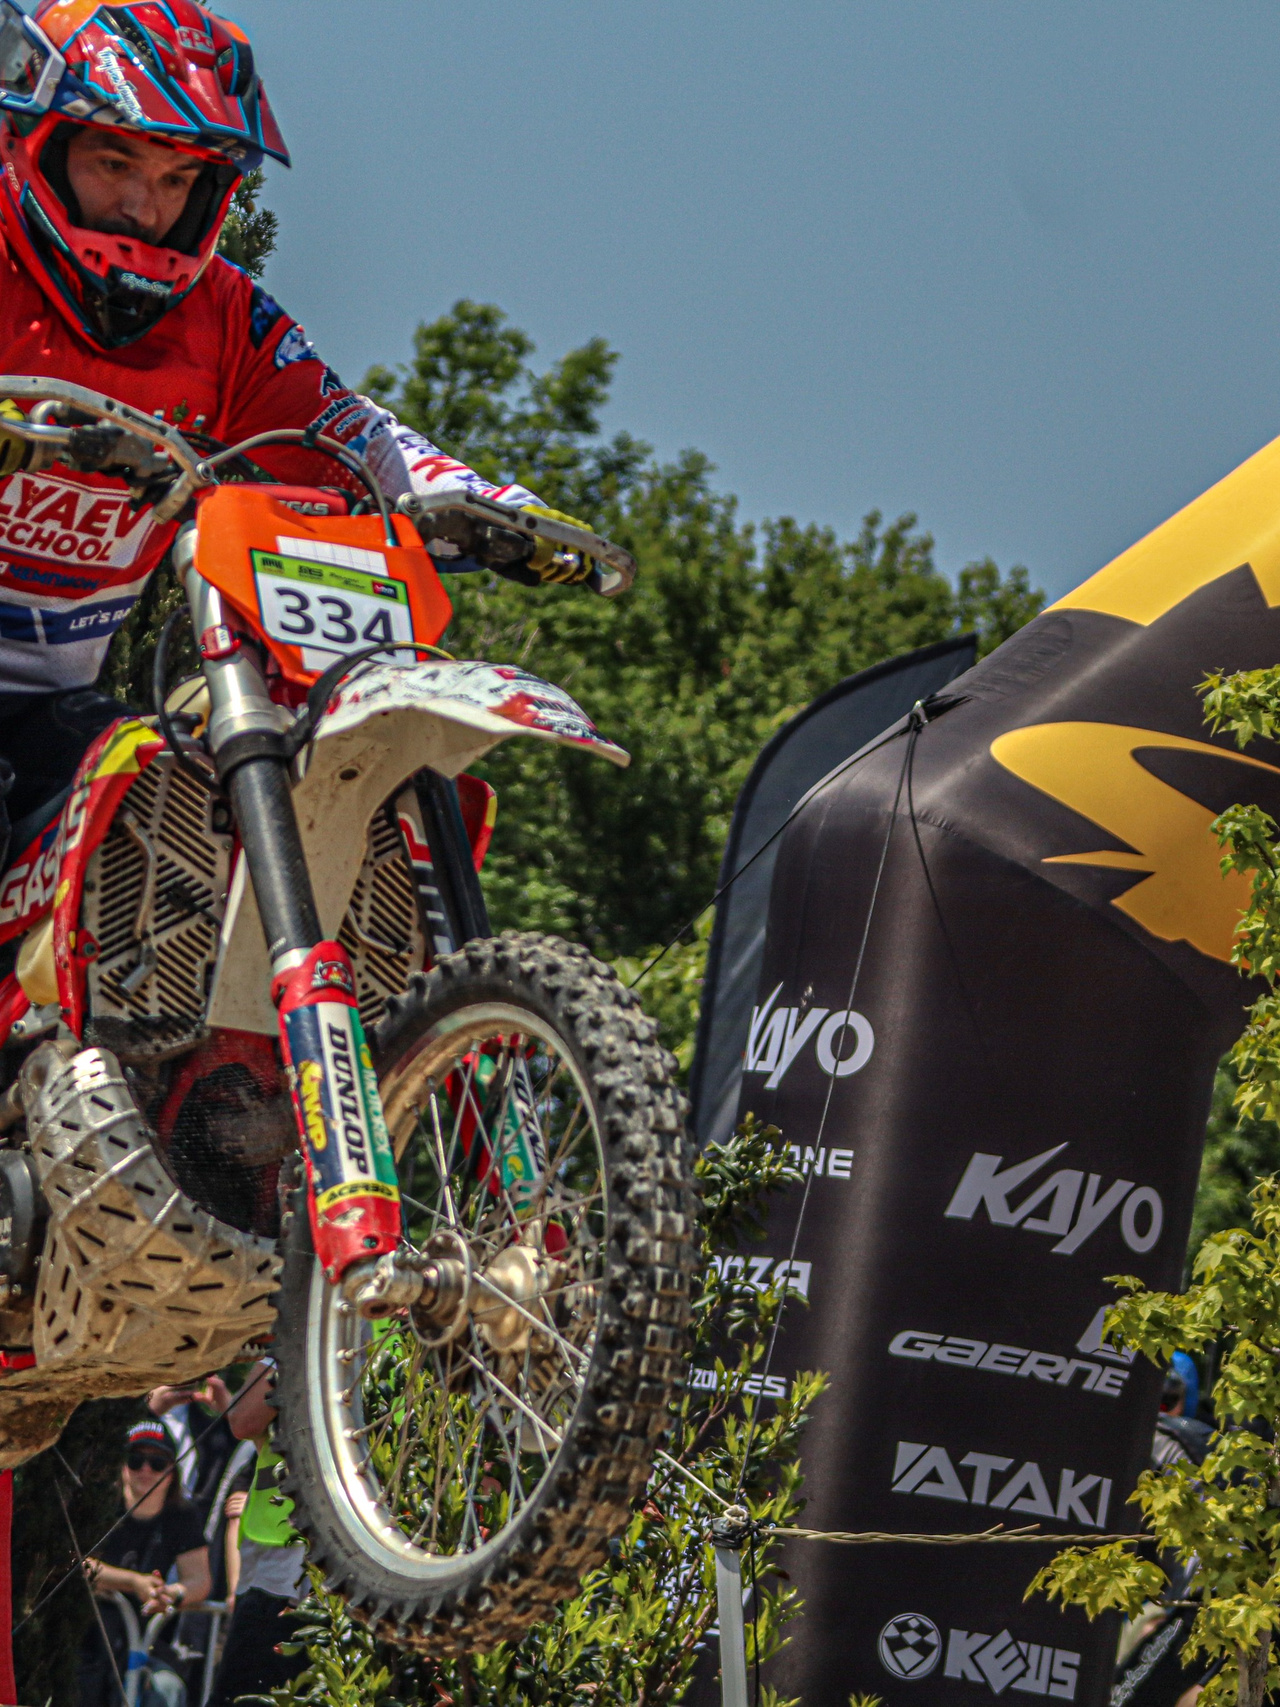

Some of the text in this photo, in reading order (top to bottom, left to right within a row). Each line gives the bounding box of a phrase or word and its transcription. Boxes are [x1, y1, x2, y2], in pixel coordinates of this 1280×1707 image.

[275, 586, 397, 657] 334
[326, 1022, 369, 1175] DUNLOP
[944, 1141, 1164, 1255] KAYO
[891, 1440, 1113, 1528] ATAKI
